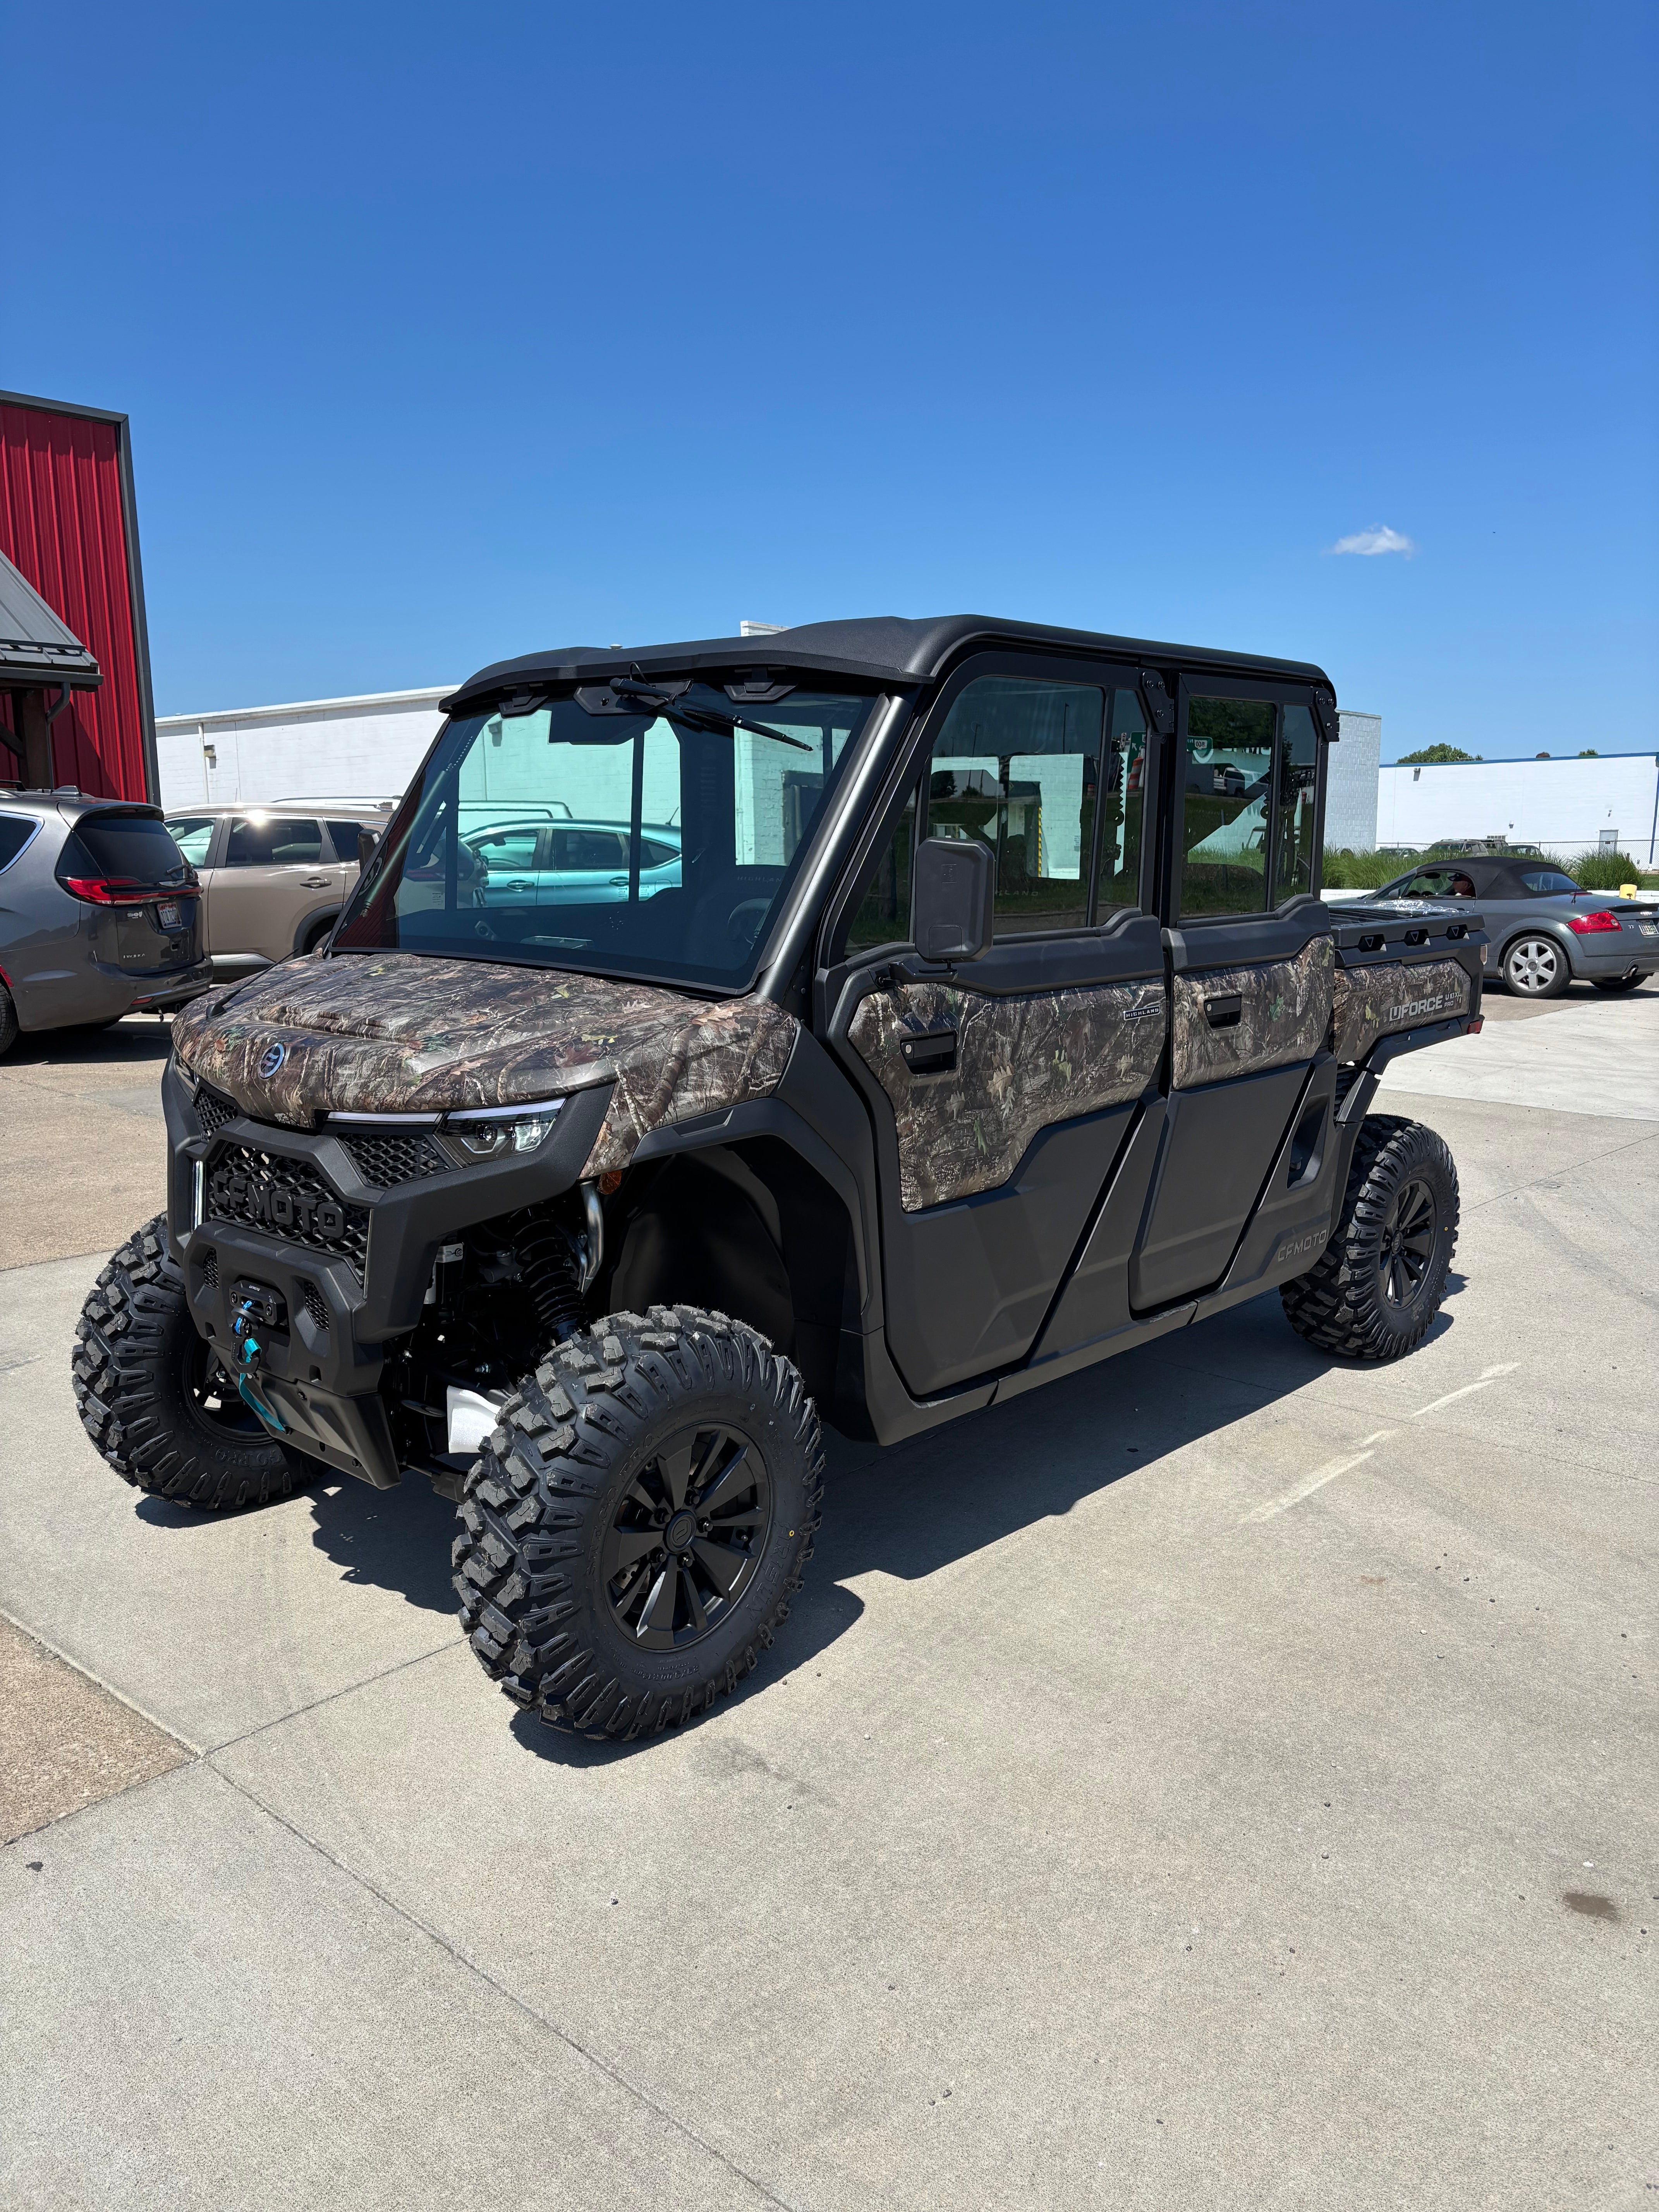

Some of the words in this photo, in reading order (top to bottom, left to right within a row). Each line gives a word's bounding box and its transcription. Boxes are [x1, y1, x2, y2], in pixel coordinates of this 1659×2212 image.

[1126, 1008, 1159, 1018] HIGHLAND
[213, 1171, 346, 1238] CFMOTO
[1278, 1229, 1327, 1262] CFMOTO
